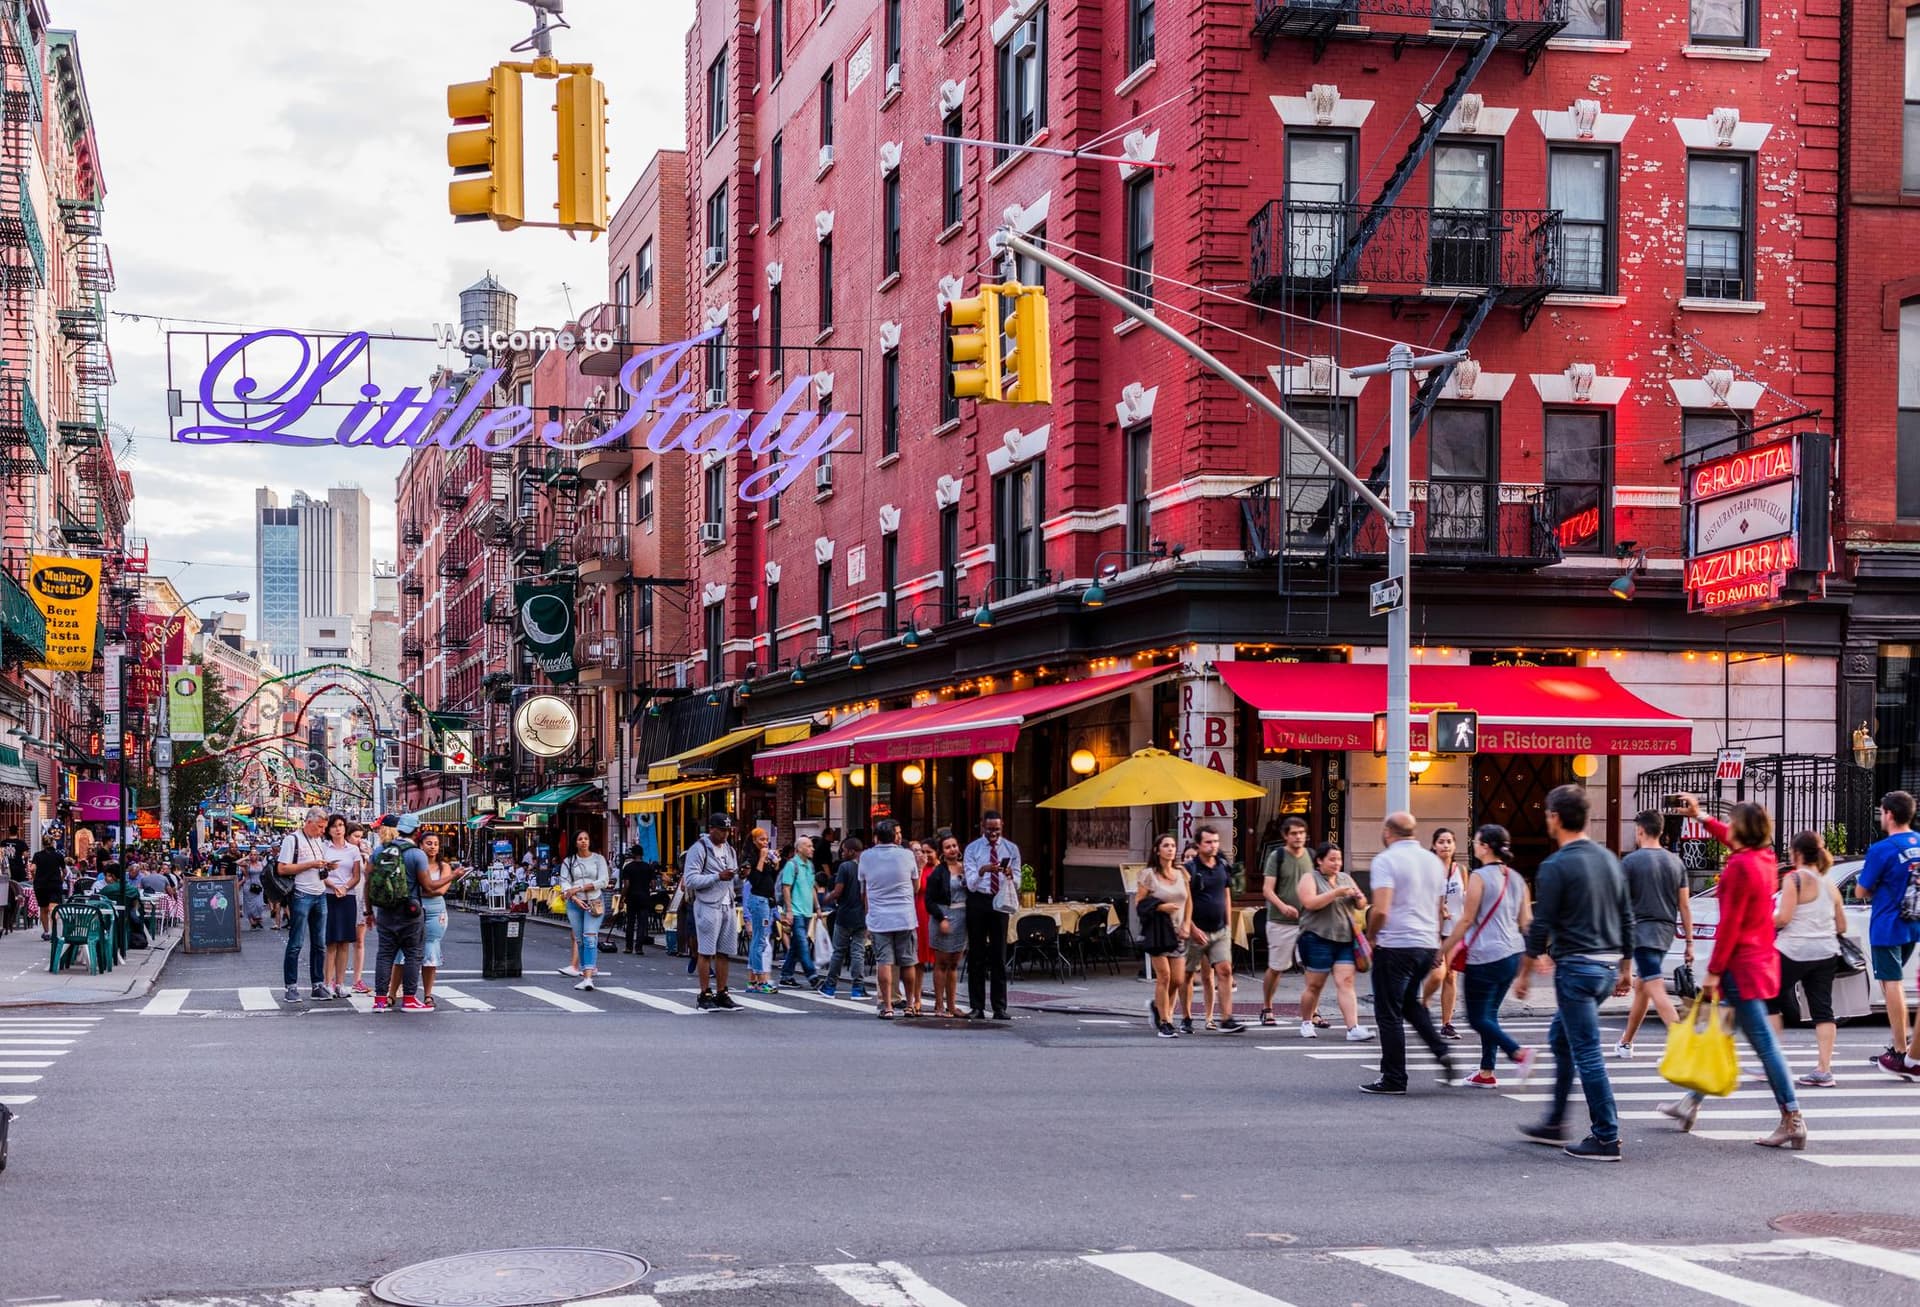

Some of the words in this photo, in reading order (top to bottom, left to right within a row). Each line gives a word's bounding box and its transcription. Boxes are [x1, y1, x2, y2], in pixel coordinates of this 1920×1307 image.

[433, 323, 575, 351] Welcome
[584, 328, 614, 352] to
[177, 329, 533, 452] Little
[542, 327, 854, 502] Italy
[1696, 448, 1793, 496] GROTTA
[1688, 544, 1792, 589] AZZURRA
[44, 570, 86, 584] Mulberry
[41, 582, 68, 594] Street
[70, 584, 86, 595] Bar
[47, 605, 77, 616] Beer
[1278, 732, 1295, 744] 177
[1299, 732, 1344, 747] Mulberry
[1347, 734, 1360, 745] St.
[1503, 730, 1592, 749] Ristorante
[1610, 740, 1677, 750] 212.925.8775
[1717, 761, 1742, 778] ATM
